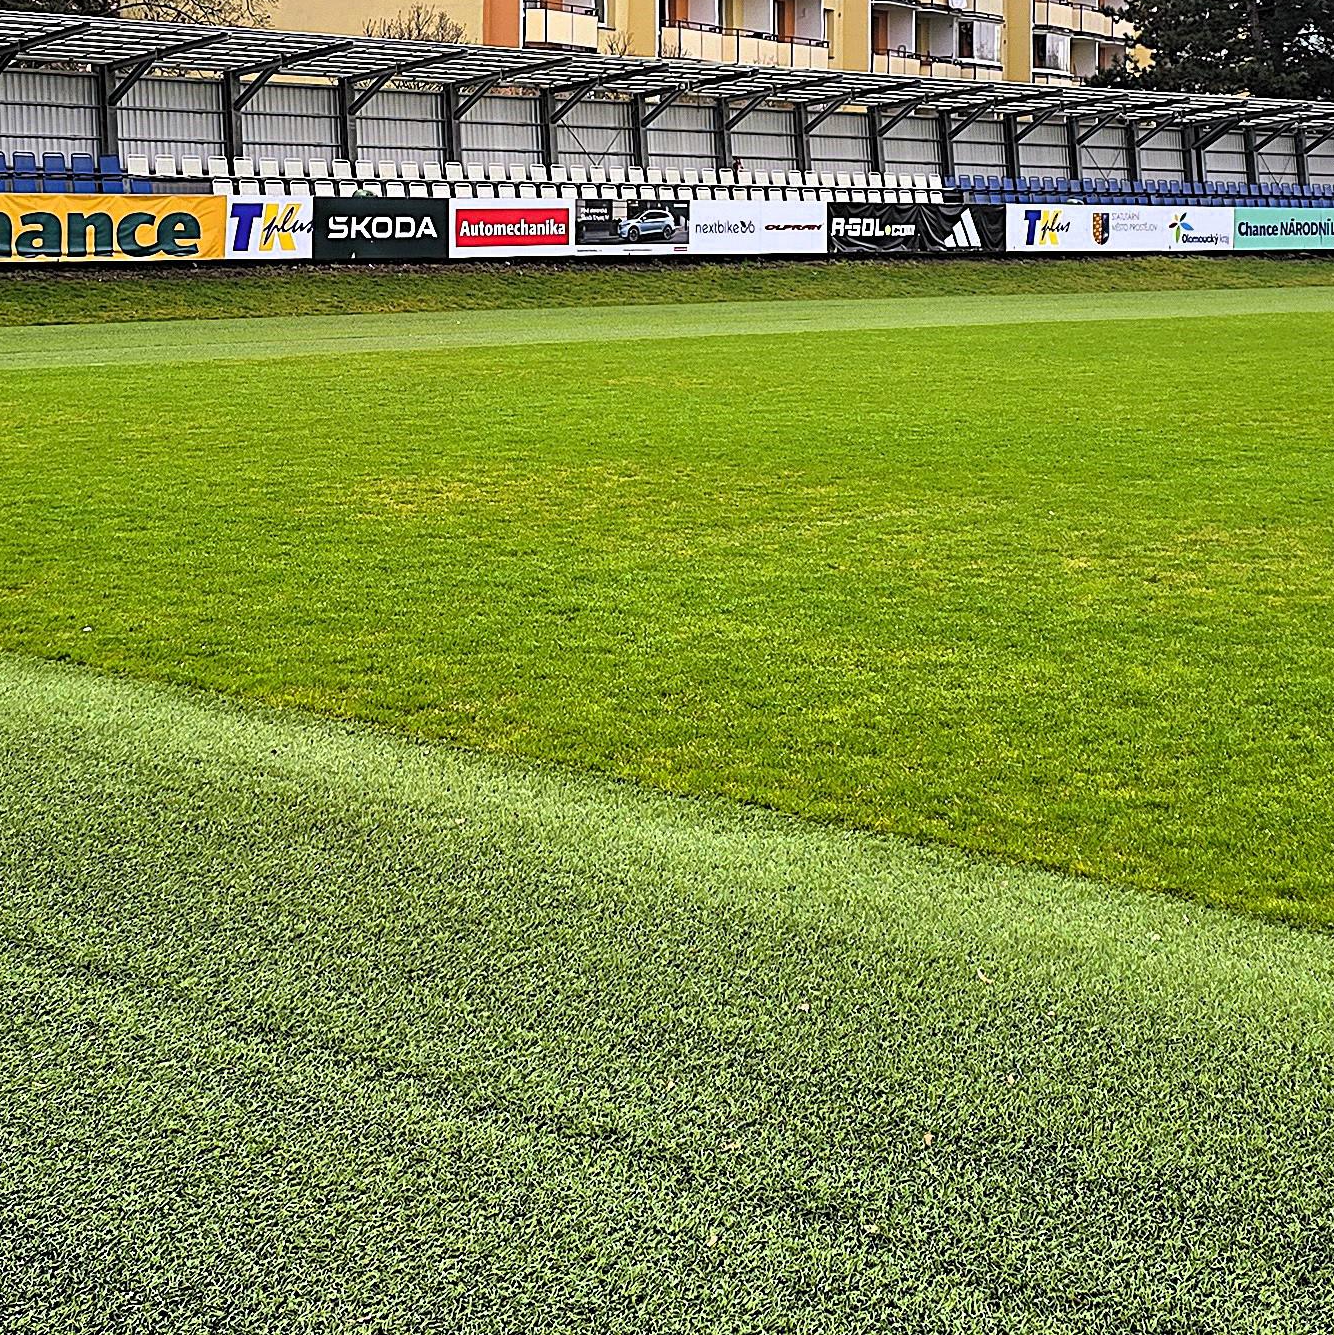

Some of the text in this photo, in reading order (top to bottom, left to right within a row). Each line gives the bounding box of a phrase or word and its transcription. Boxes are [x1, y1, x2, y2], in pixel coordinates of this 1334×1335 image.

[230, 203, 302, 251] TK
[262, 206, 314, 245] plus
[459, 219, 566, 237] Automechanika
[695, 219, 740, 234] nextbike
[1024, 209, 1063, 246] TK
[1237, 221, 1279, 236] Chance
[1280, 218, 1330, 236] NÁRODNÍ
[1181, 233, 1219, 245] Olomoucký
